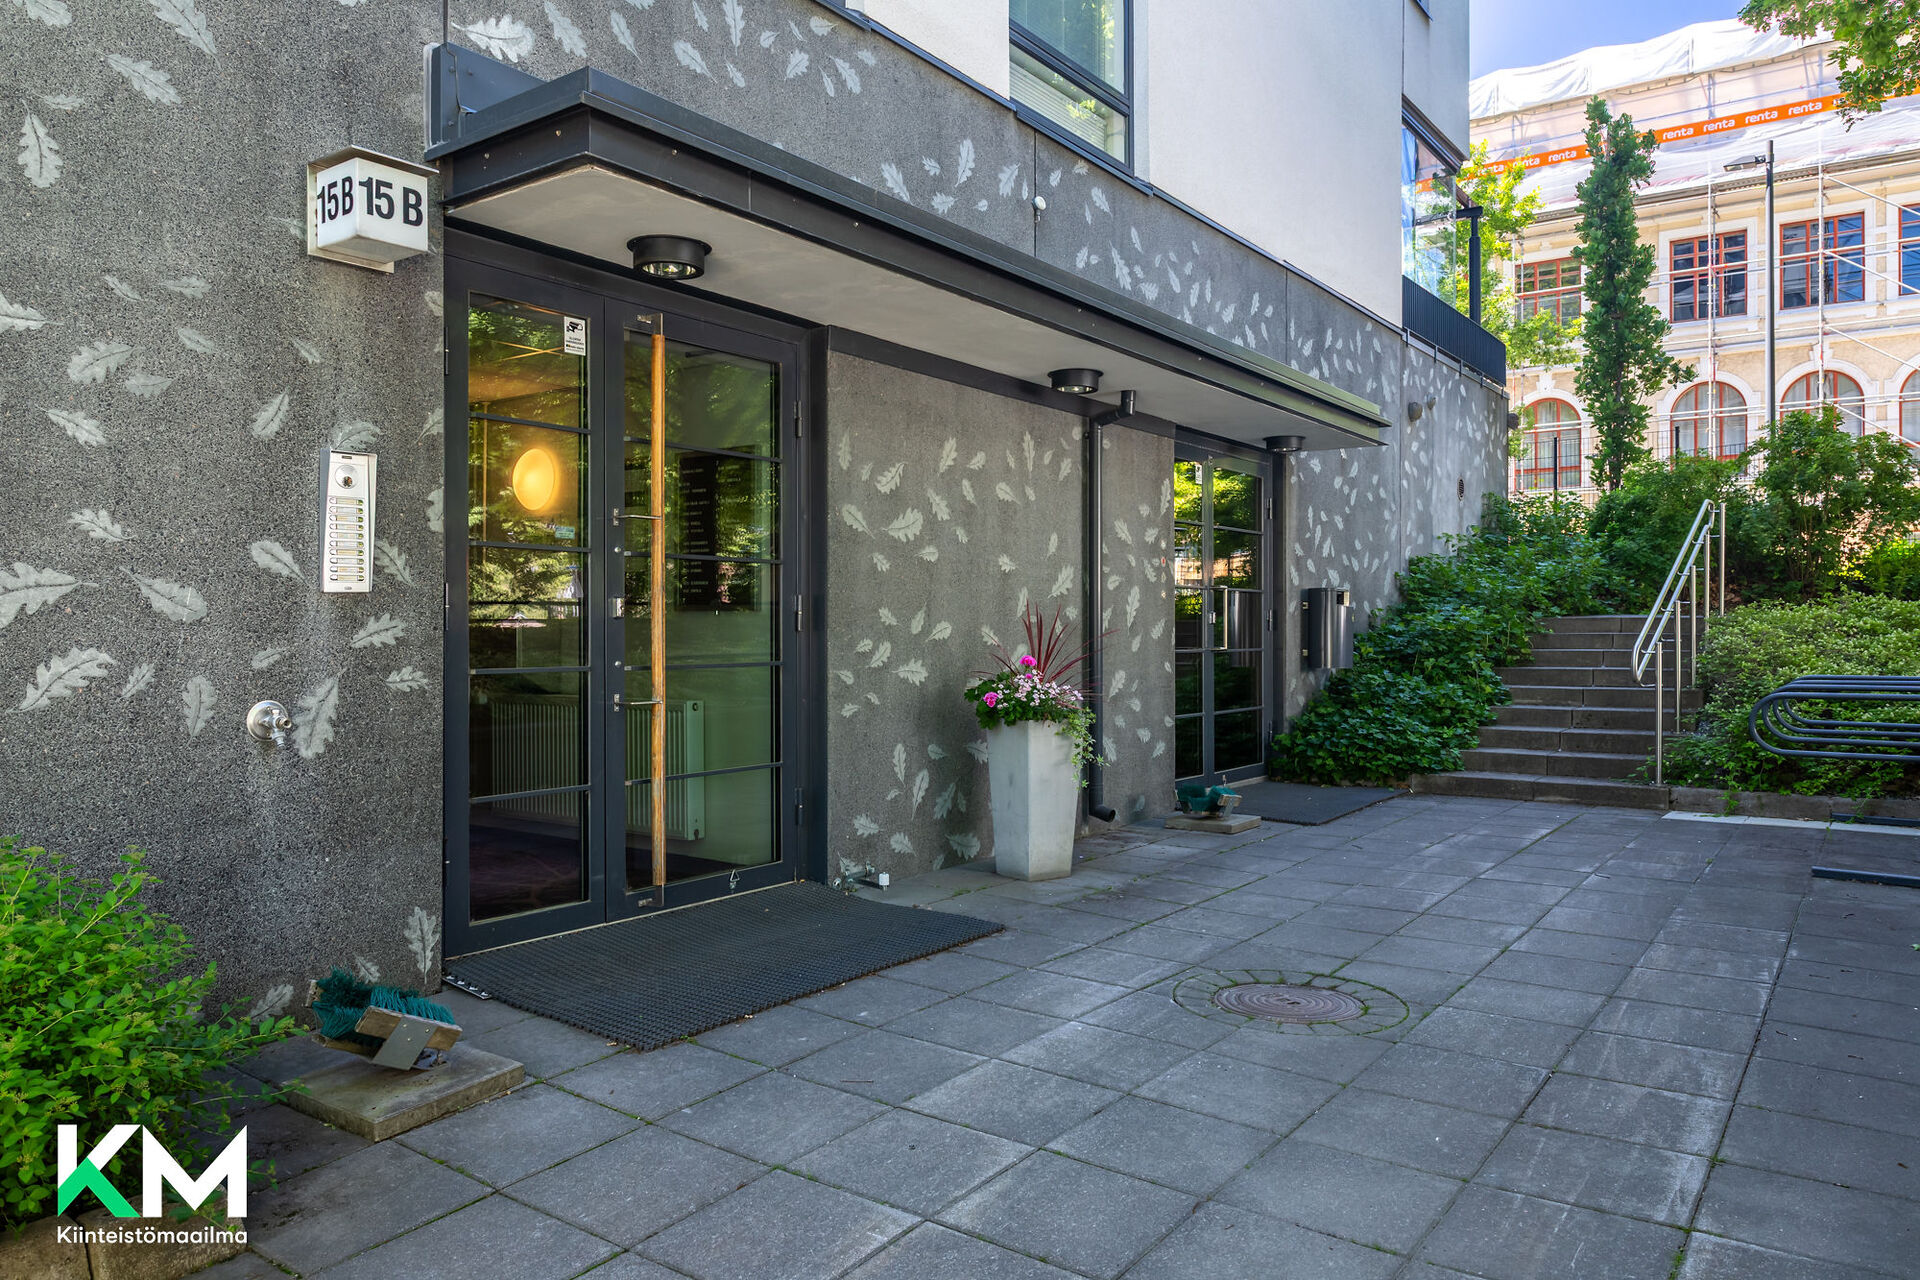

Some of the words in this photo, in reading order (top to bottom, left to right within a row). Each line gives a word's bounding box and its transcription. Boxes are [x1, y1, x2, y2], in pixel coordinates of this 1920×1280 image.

[1548, 149, 1577, 162] renta
[1662, 127, 1694, 140] renta
[1703, 118, 1735, 132] renta
[1744, 110, 1778, 124] renta
[1788, 101, 1822, 116] renta
